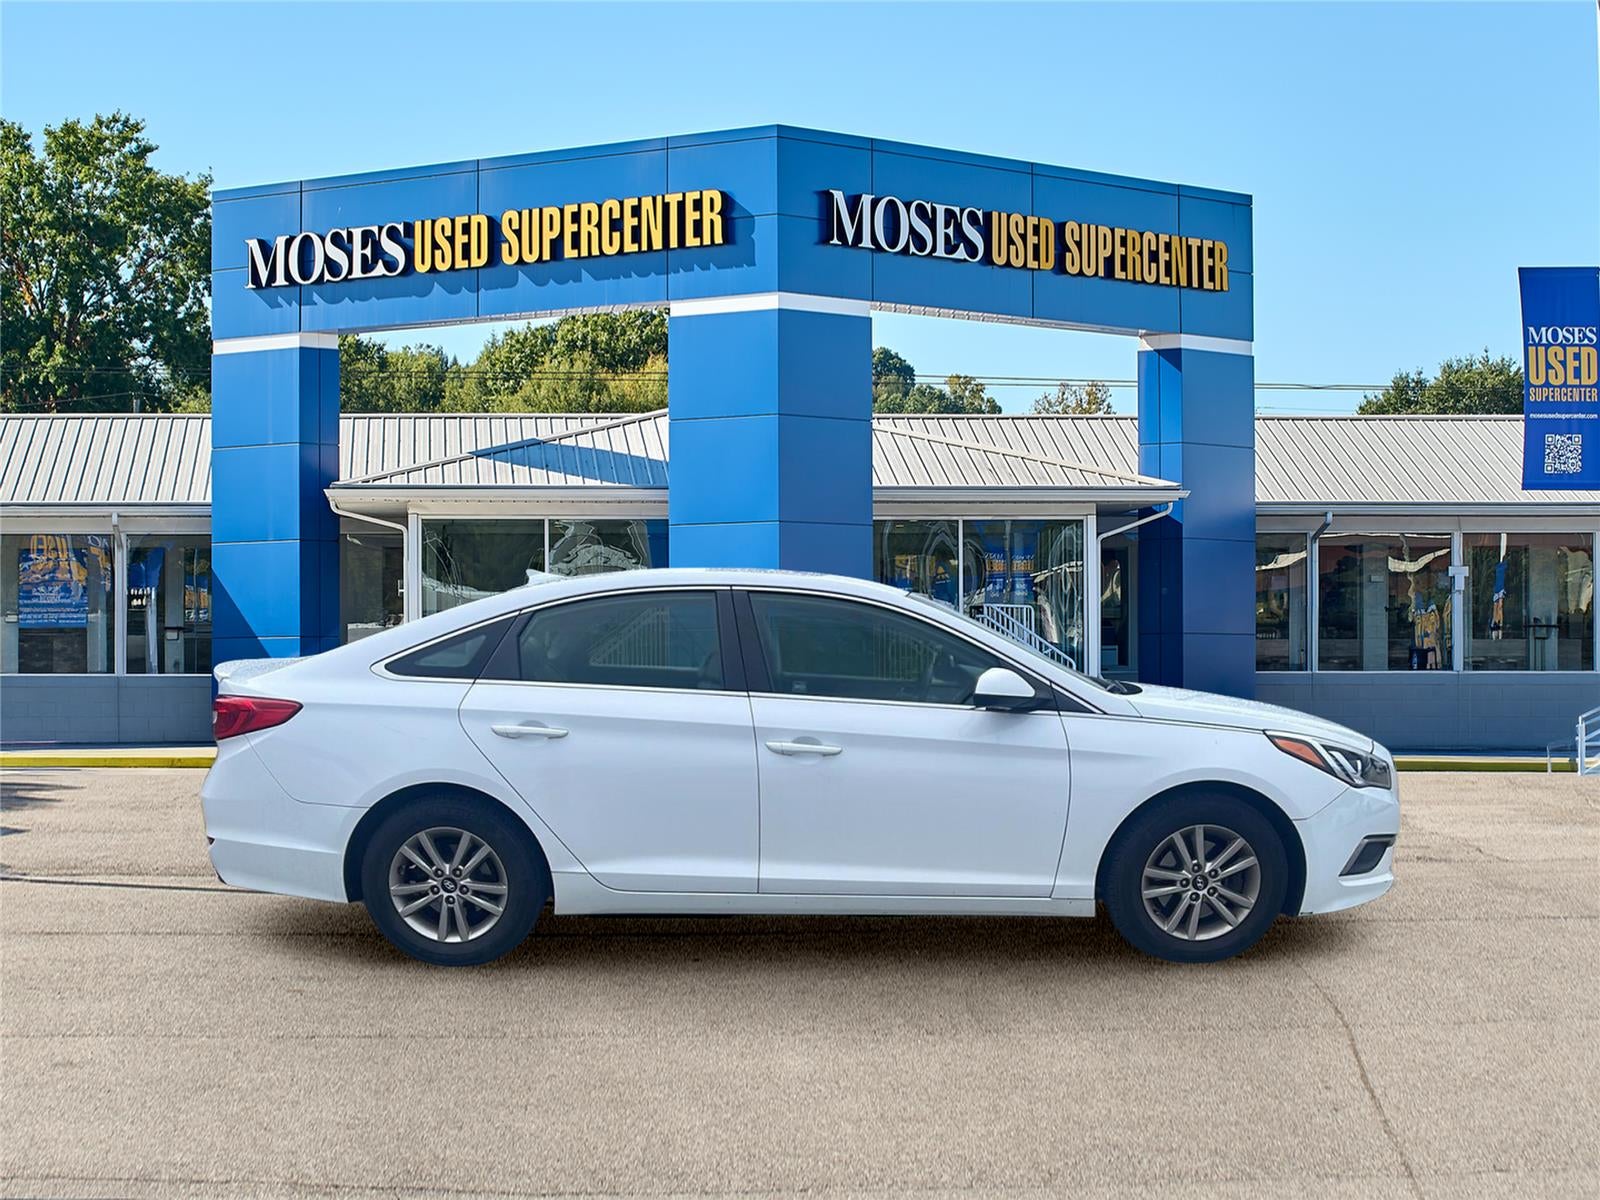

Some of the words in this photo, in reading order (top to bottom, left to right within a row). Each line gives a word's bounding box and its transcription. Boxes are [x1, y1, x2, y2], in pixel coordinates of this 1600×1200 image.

[245, 222, 406, 289] MOSES
[413, 214, 489, 273] USED
[500, 189, 724, 265] SUPERCENTER
[828, 189, 985, 263] MOSES
[991, 210, 1055, 271] USED
[1064, 220, 1230, 292] SUPERCENTER
[1527, 326, 1597, 344] MOSES
[1528, 346, 1598, 385] USED
[1529, 387, 1598, 402] SUPERCENTER
